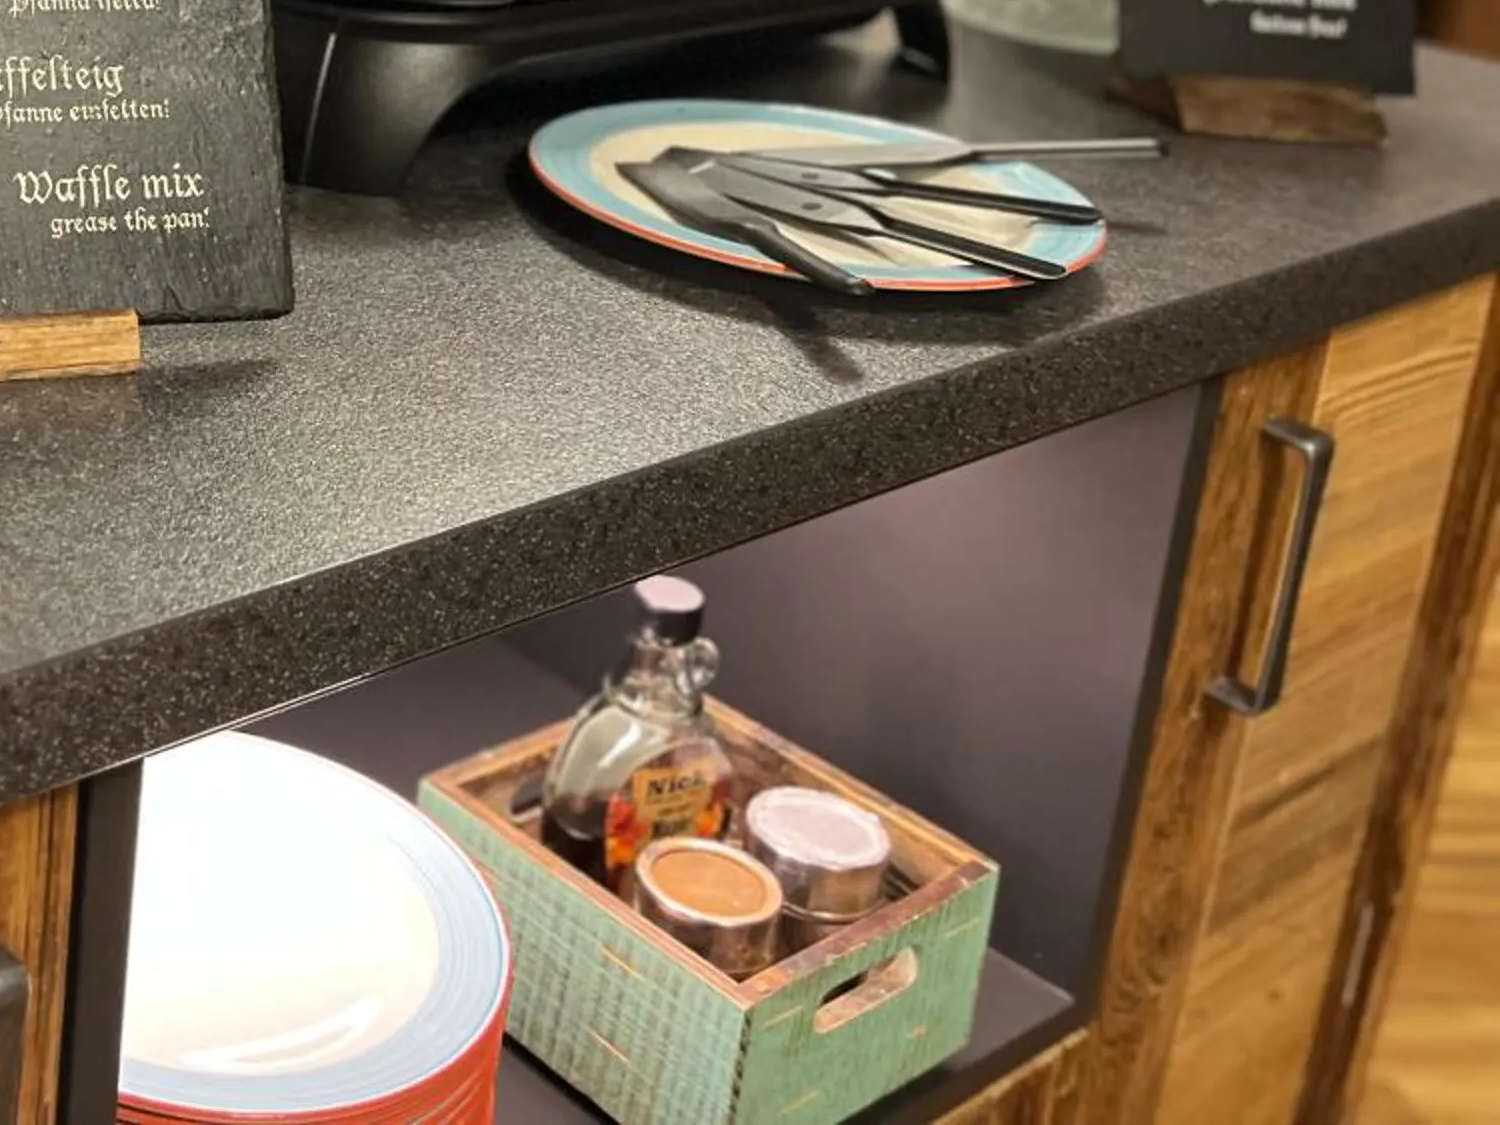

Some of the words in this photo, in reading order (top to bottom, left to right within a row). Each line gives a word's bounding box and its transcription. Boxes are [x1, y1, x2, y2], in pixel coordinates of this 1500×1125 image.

[14, 164, 131, 209] Waffle
[141, 162, 204, 199] mix
[51, 214, 118, 239] grease
[124, 206, 157, 231] the
